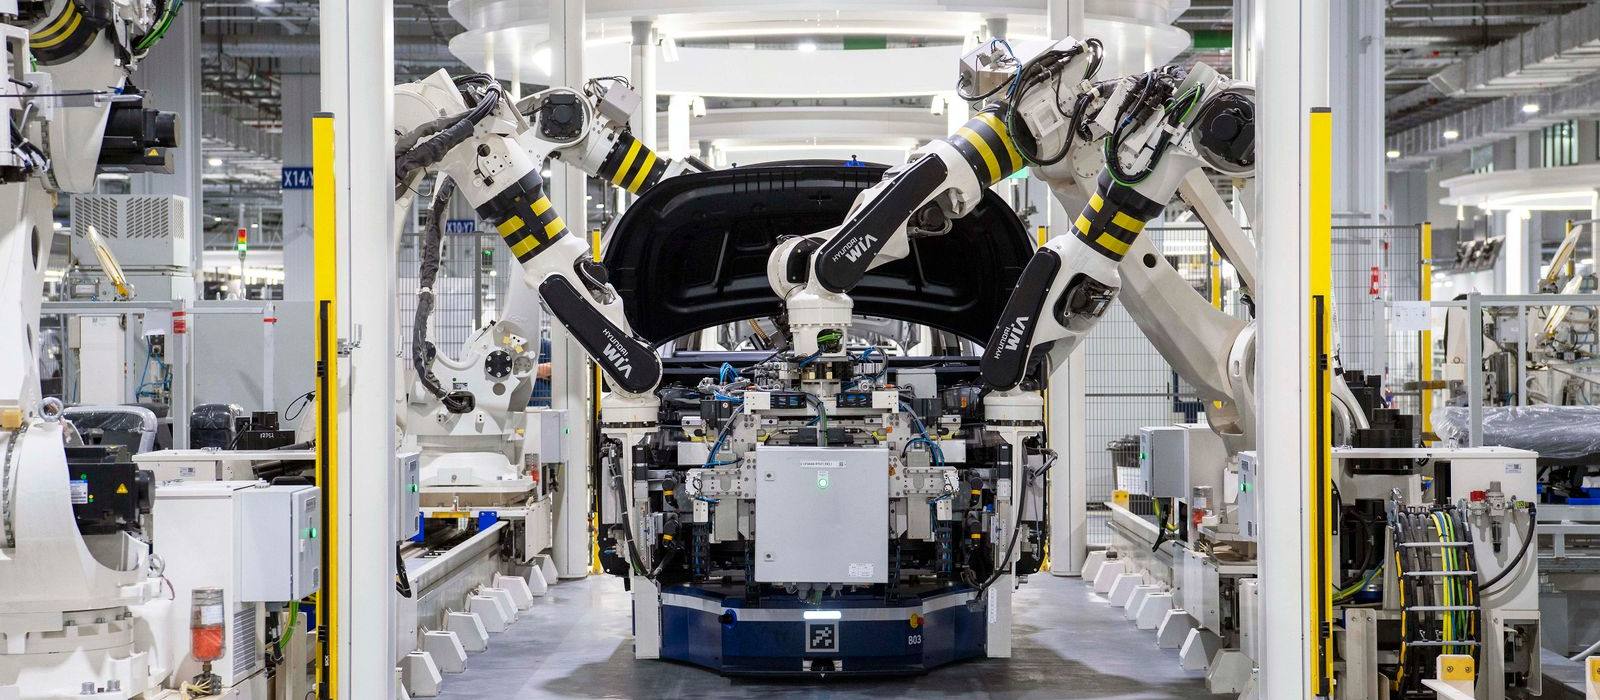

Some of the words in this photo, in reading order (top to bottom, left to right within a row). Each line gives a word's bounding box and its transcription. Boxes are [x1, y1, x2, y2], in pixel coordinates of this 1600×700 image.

[832, 236, 858, 262] HYUNDAI
[602, 328, 629, 357] HYUNDAI
[993, 326, 1010, 360] HYUNDAI
